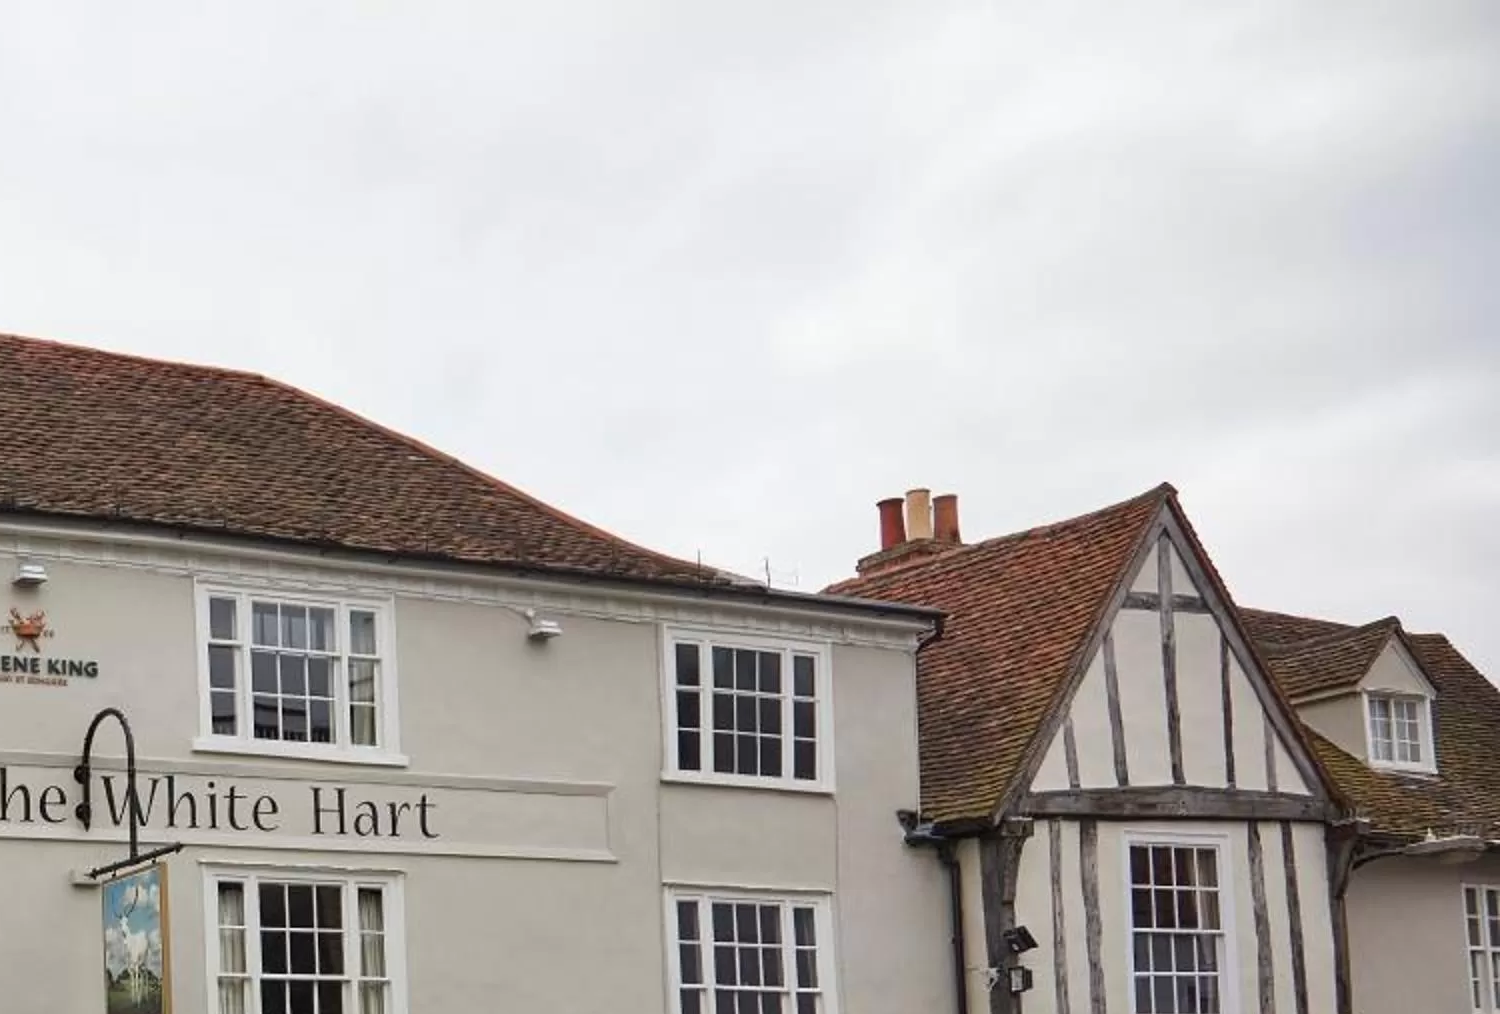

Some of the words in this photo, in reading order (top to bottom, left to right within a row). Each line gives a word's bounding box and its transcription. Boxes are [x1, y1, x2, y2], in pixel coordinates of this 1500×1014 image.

[47, 659, 99, 678] KING
[101, 775, 279, 831] White
[310, 786, 439, 839] Hart
